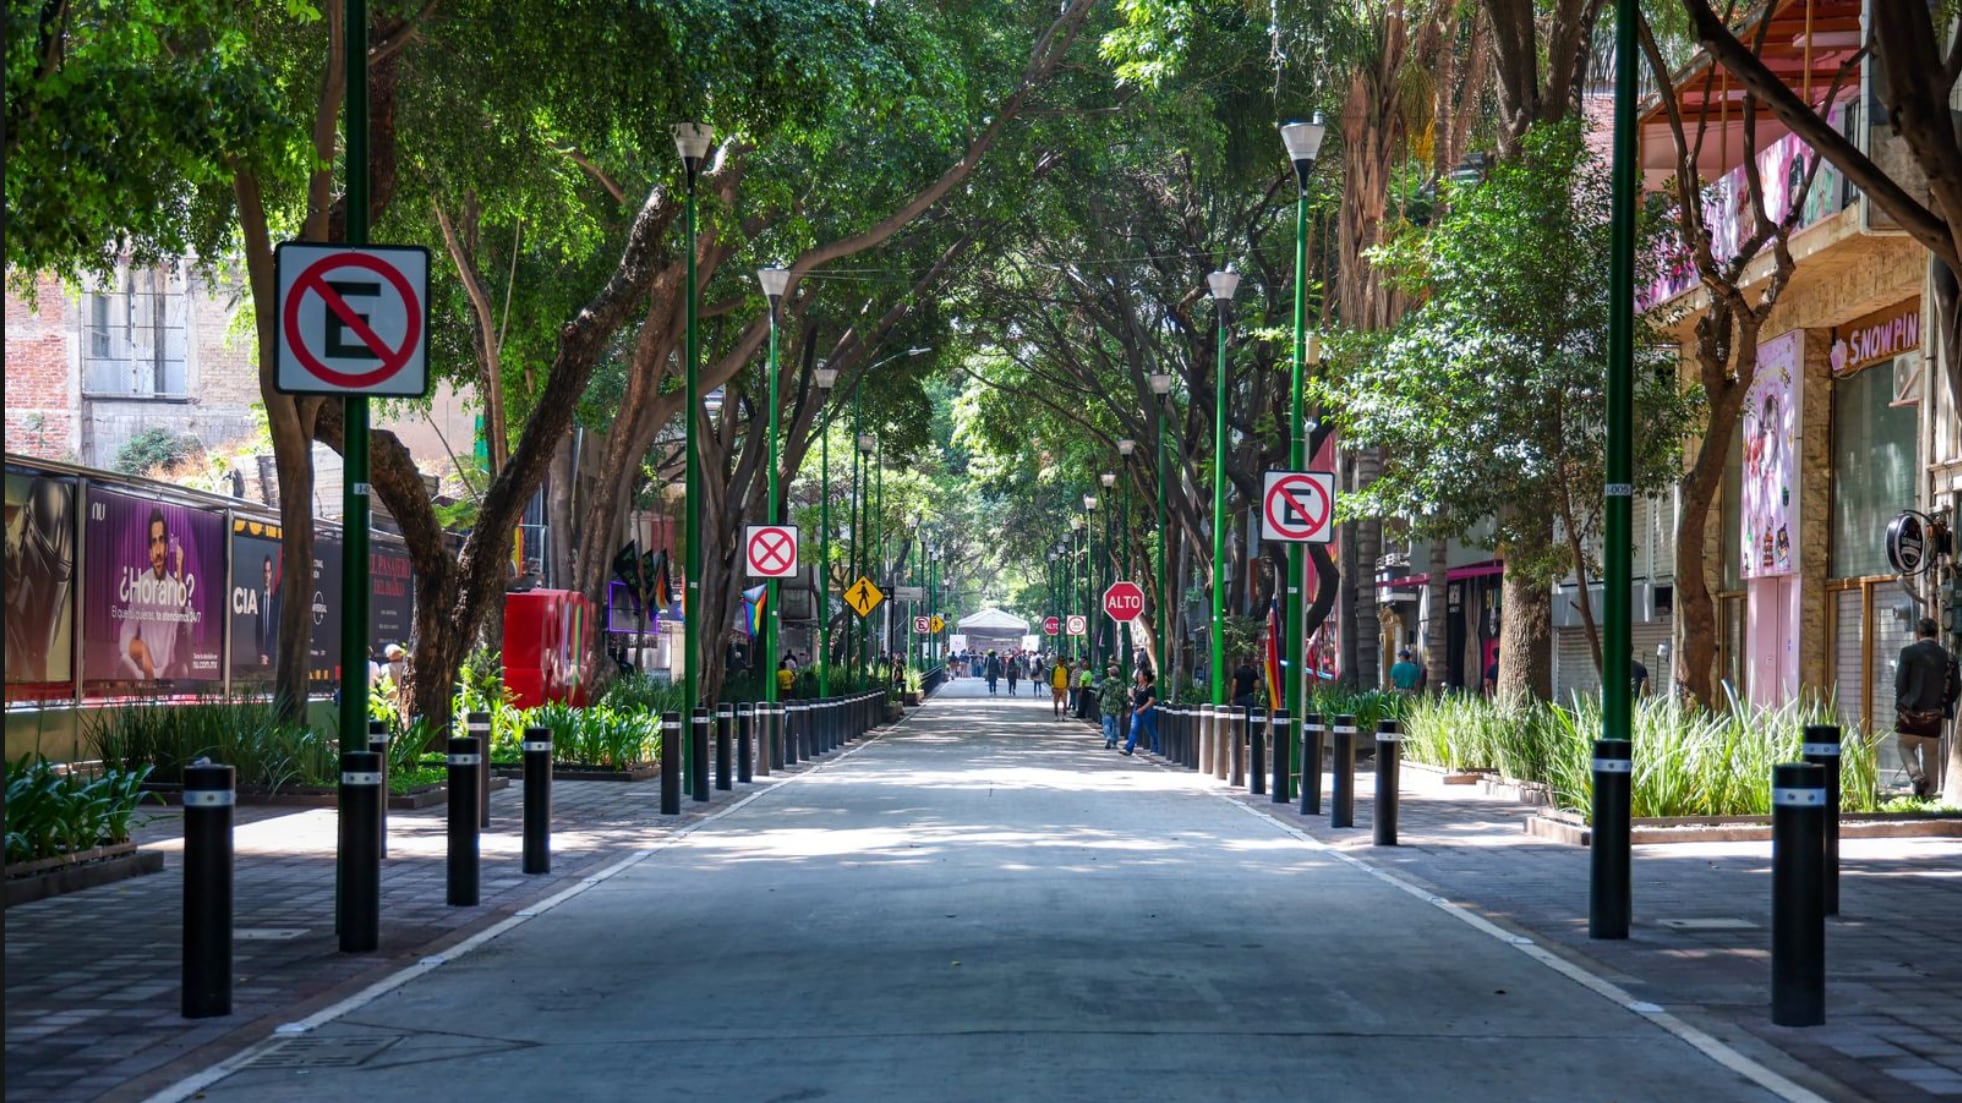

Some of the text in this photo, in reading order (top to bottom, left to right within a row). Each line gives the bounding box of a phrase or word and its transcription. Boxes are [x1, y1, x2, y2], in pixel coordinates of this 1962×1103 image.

[325, 281, 381, 359] E
[1284, 488, 1311, 526] E
[119, 565, 196, 608] ¿Horario?
[233, 587, 258, 615] CIA
[1108, 595, 1141, 609] ALTO
